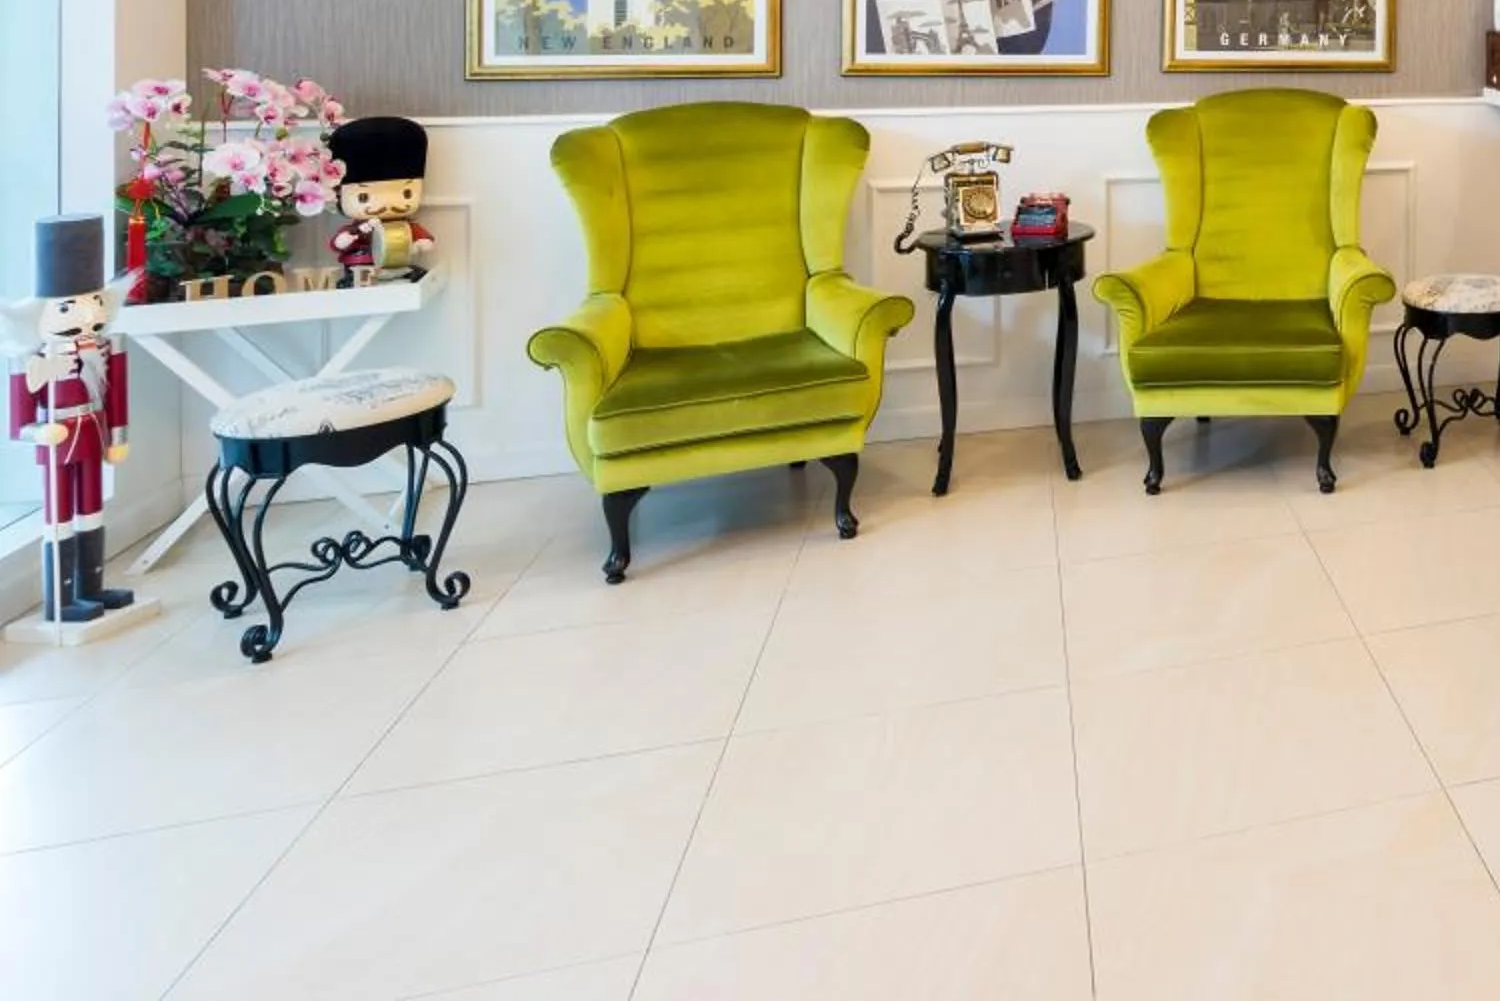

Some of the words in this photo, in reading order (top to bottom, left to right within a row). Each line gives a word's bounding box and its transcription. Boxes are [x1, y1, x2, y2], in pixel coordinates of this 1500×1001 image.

[518, 35, 577, 50] NEW
[602, 35, 735, 50] ENGLAND
[1219, 31, 1348, 46] GERMANY
[179, 265, 378, 303] HOME
